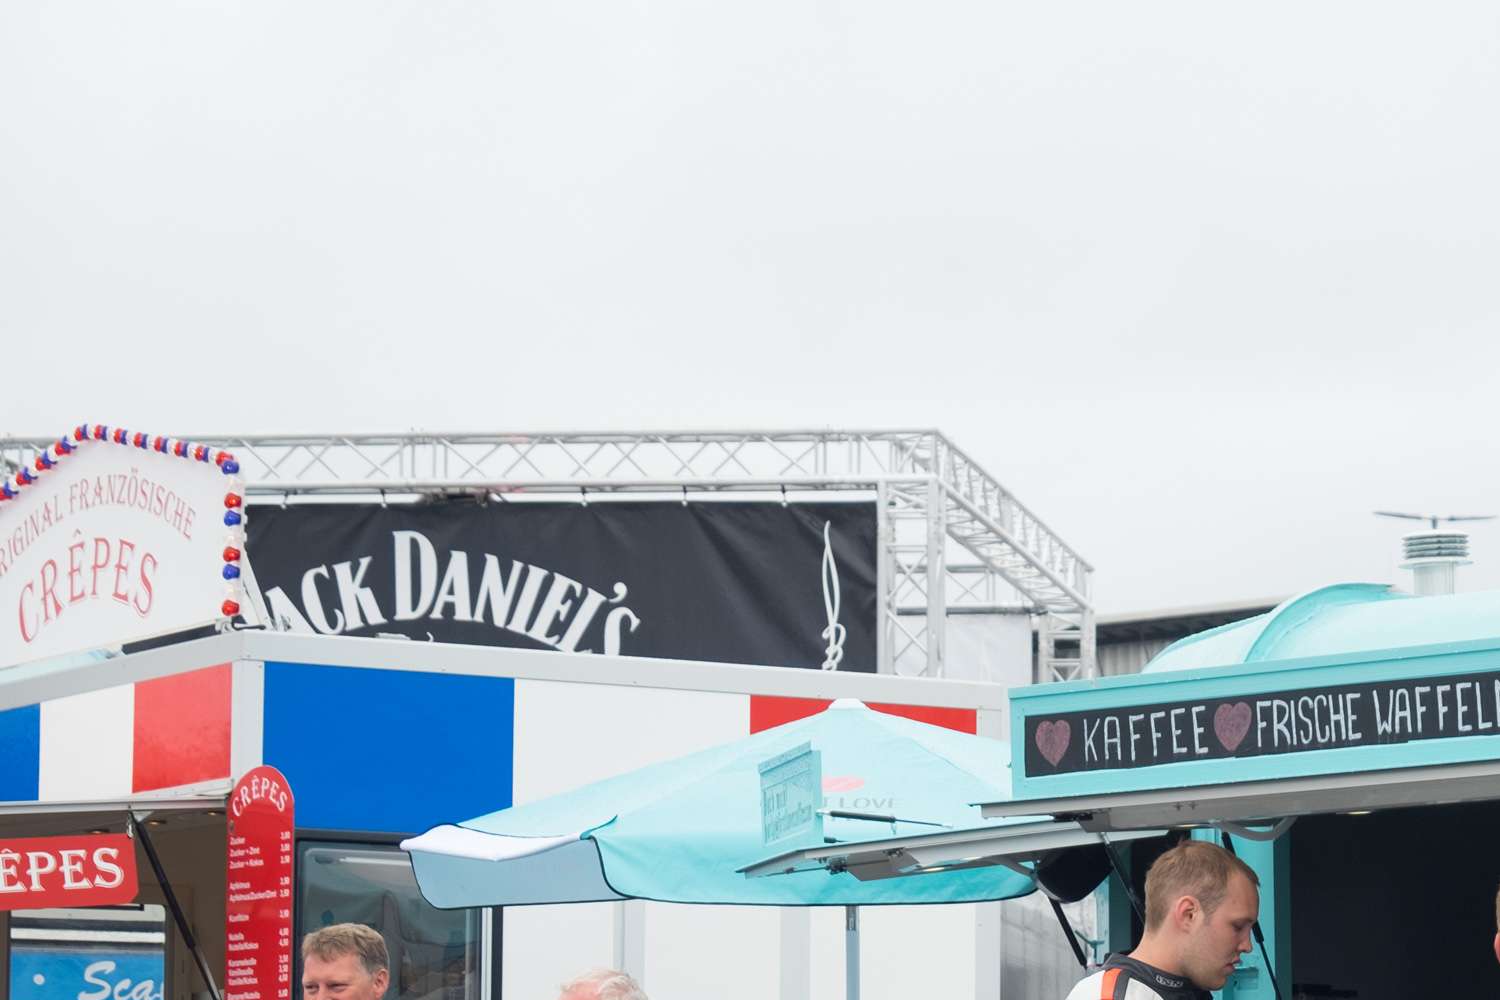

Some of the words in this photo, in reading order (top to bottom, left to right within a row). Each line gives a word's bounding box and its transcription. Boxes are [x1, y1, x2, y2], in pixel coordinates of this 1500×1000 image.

[68, 466, 197, 540] FRANZÖSISCHE
[18, 528, 159, 644] CRÊPES
[265, 555, 388, 636] ACK
[1084, 704, 1210, 763] KAFFEE
[1256, 692, 1362, 748] FRISCHE
[232, 775, 288, 817] CRÊPES
